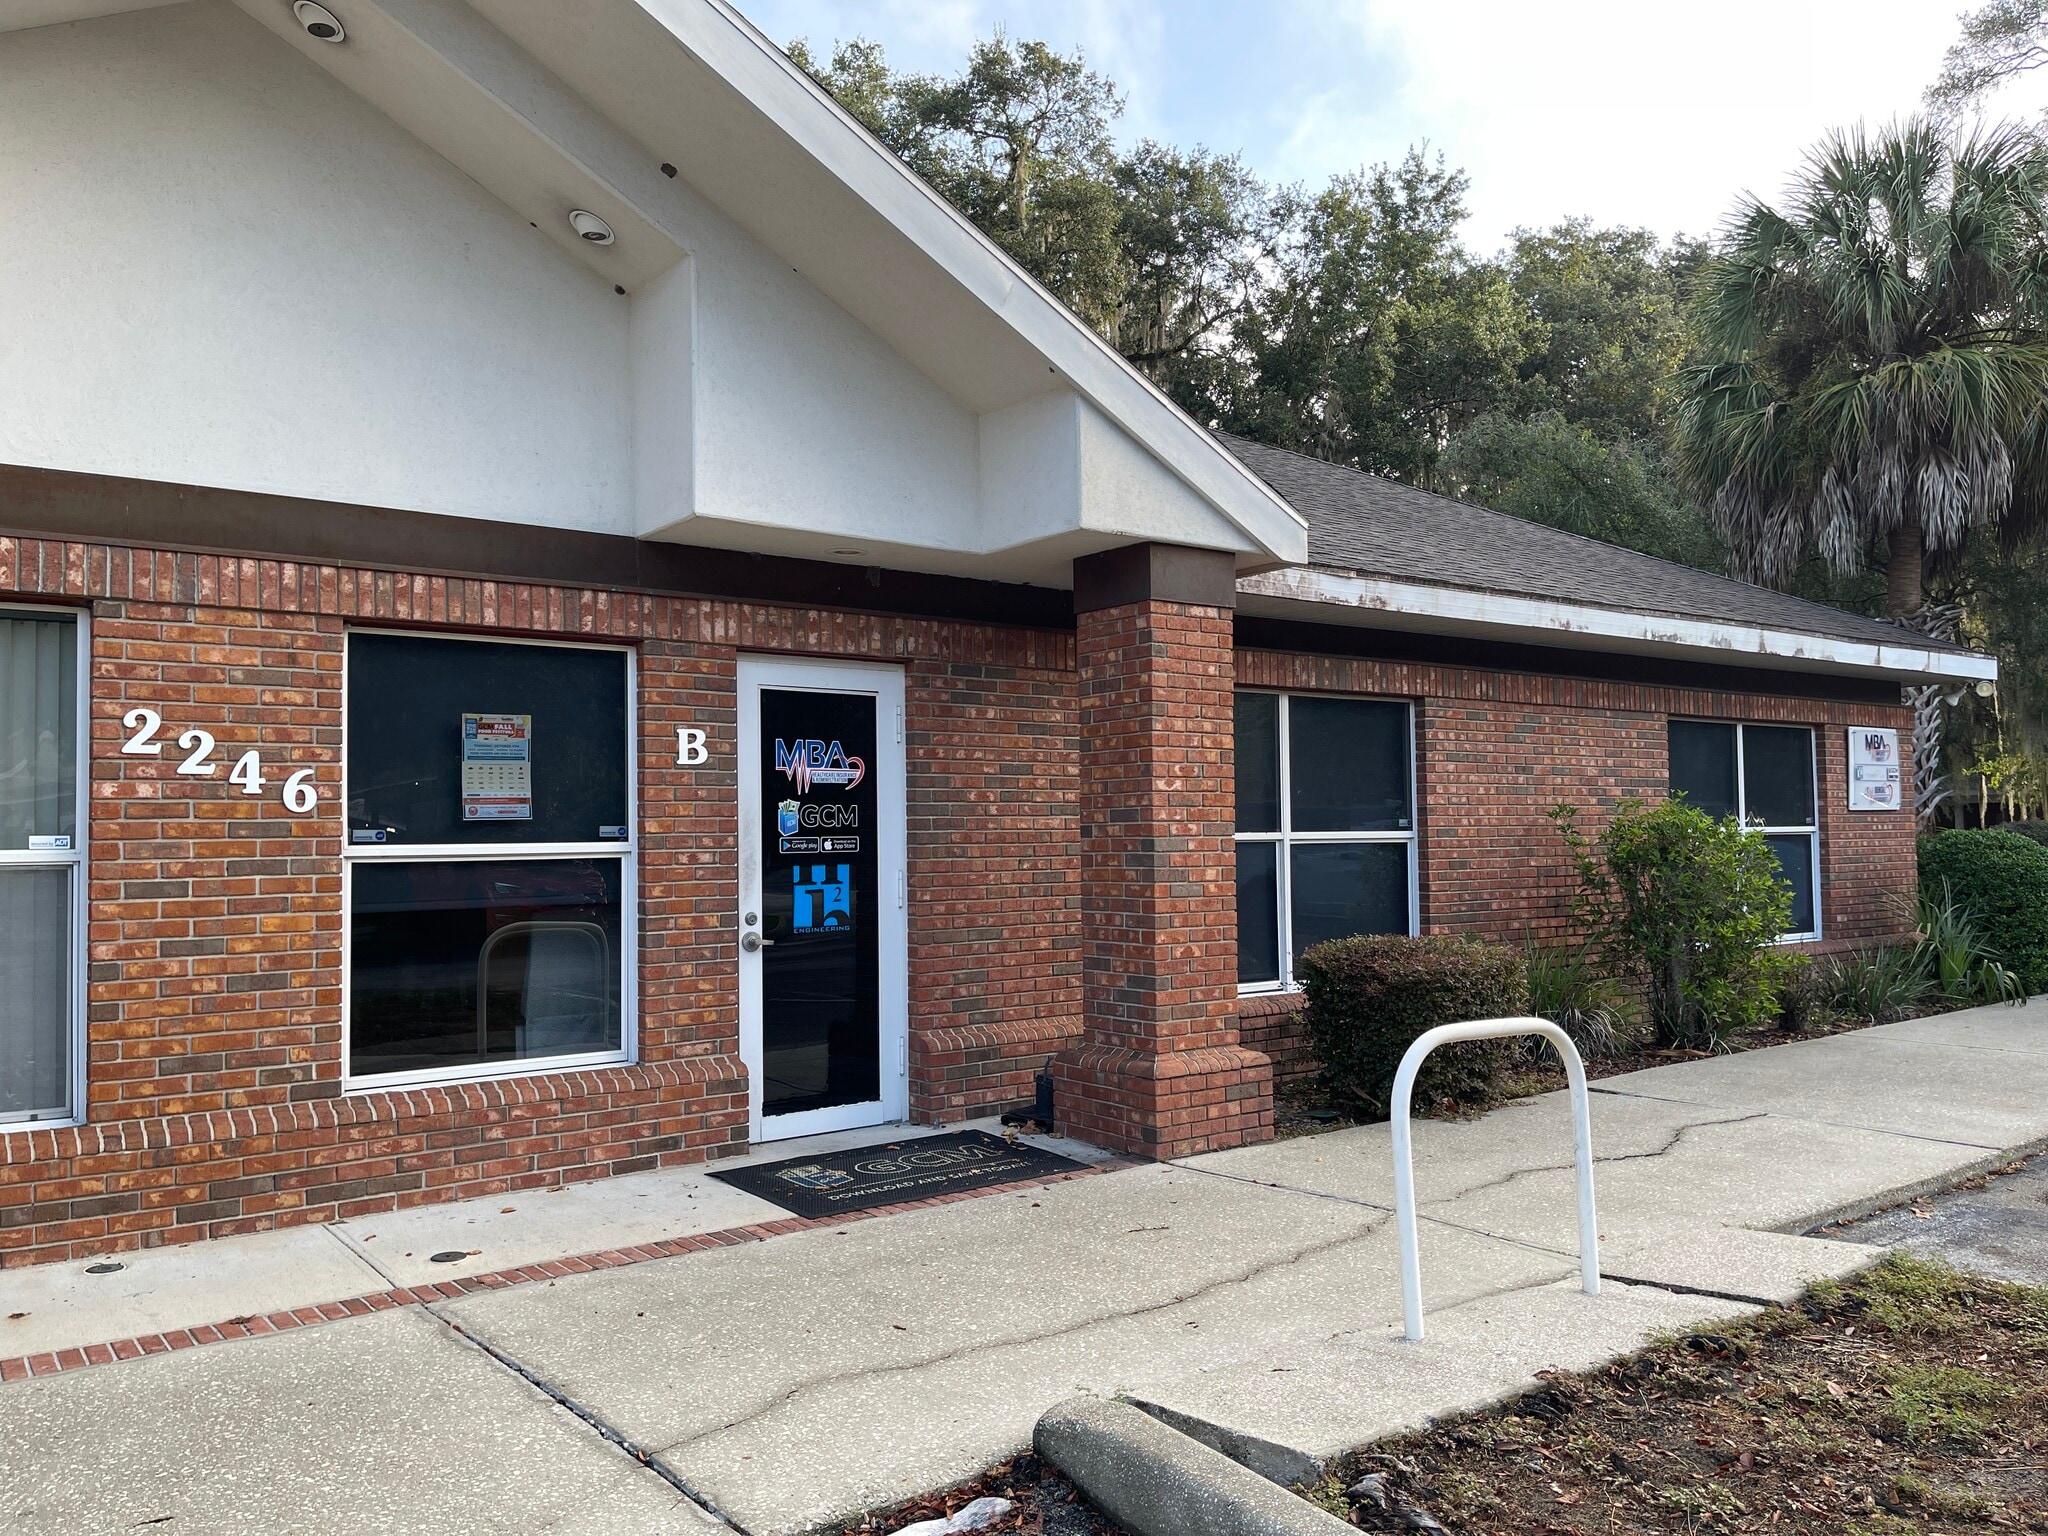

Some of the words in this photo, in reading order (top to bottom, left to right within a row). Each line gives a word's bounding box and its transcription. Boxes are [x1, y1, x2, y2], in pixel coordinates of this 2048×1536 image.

[676, 728, 709, 765] B
[776, 738, 850, 770] MBA
[1865, 734, 1886, 750] MBA
[121, 708, 318, 813] 2246
[800, 804, 858, 828] GCM
[55, 839, 68, 847] ADT
[793, 925, 851, 934] ENGINEERING
[855, 1144, 1003, 1175] GCM
[828, 1181, 914, 1200] DOWNLOAD
